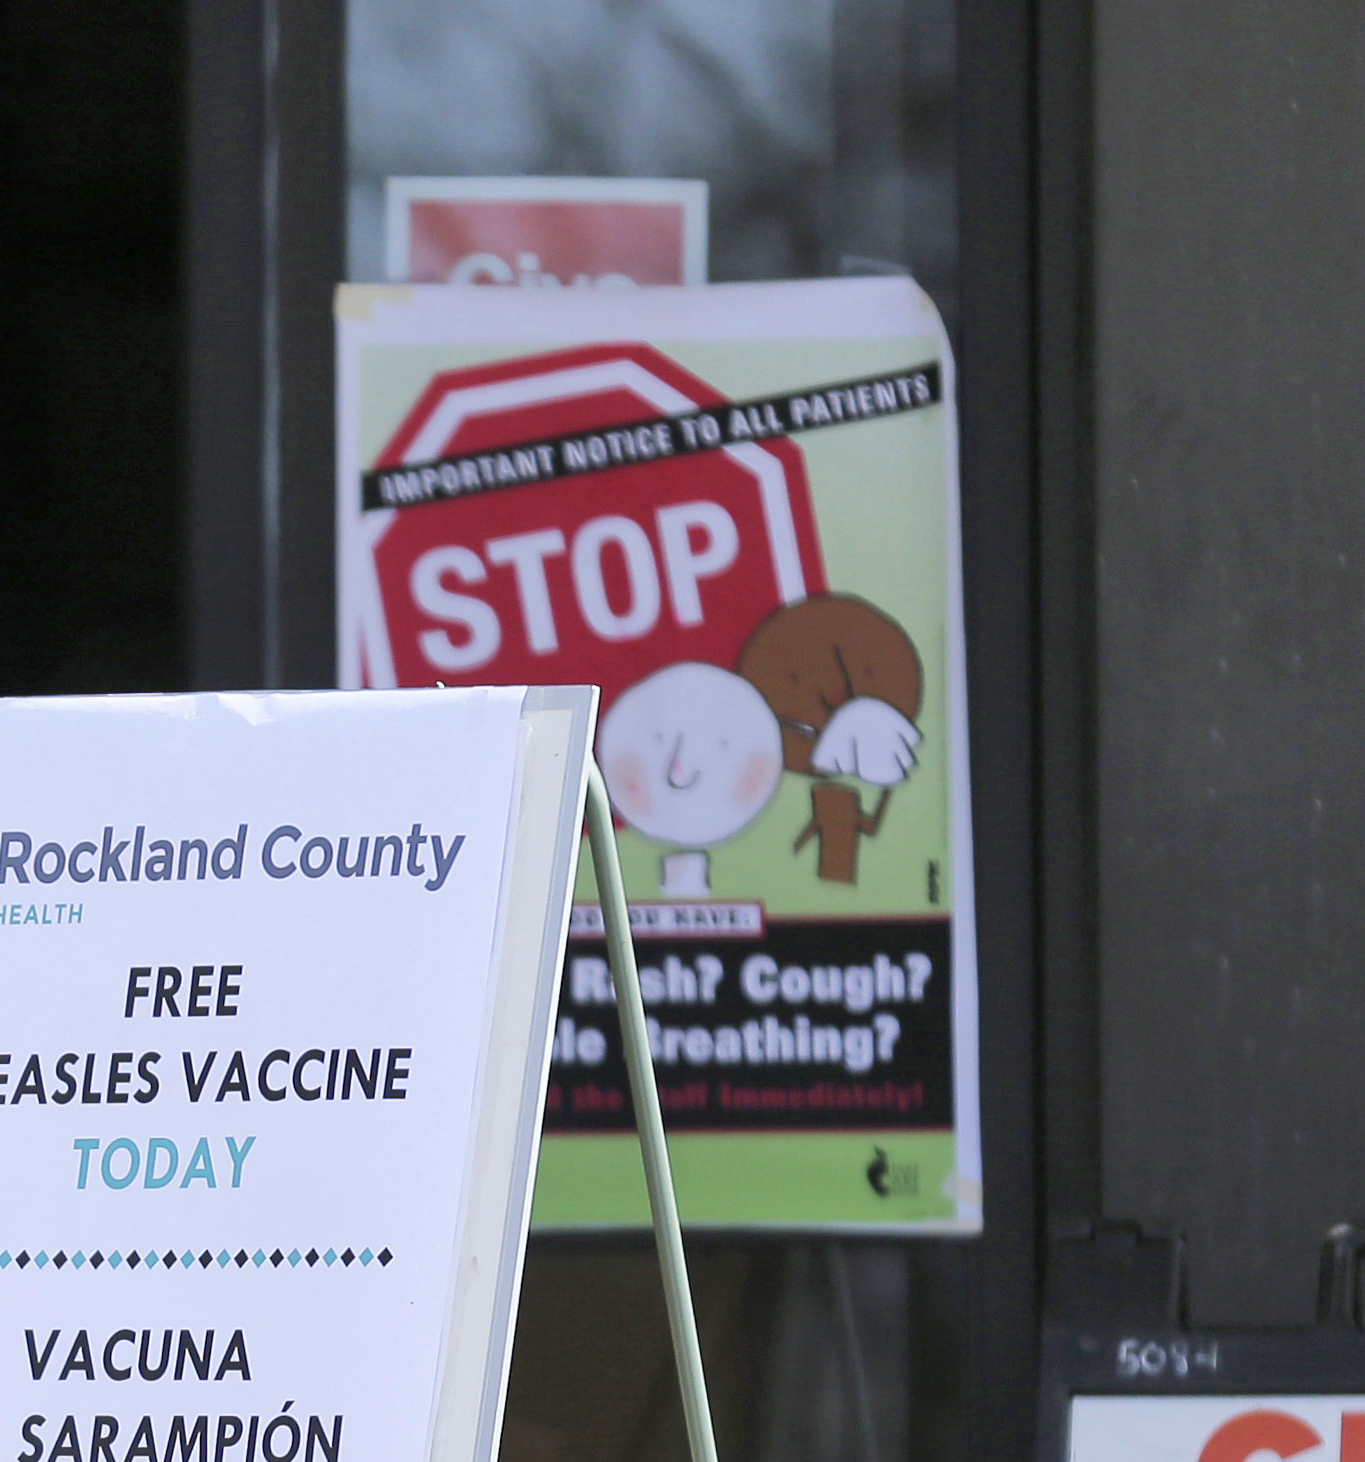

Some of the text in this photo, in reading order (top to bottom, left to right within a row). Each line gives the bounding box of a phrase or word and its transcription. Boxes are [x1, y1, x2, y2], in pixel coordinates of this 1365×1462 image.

[380, 373, 932, 504] IMPORTANT NOTICE TO ALL PATIENTS
[409, 499, 741, 672] STOP
[261, 823, 466, 892] County
[123, 965, 244, 1019] FREE
[571, 953, 932, 1011] Rsh? Cough?
[181, 1048, 413, 1103] VACCINE
[72, 1136, 257, 1190] TODAY
[24, 1328, 252, 1382] VACUNA
